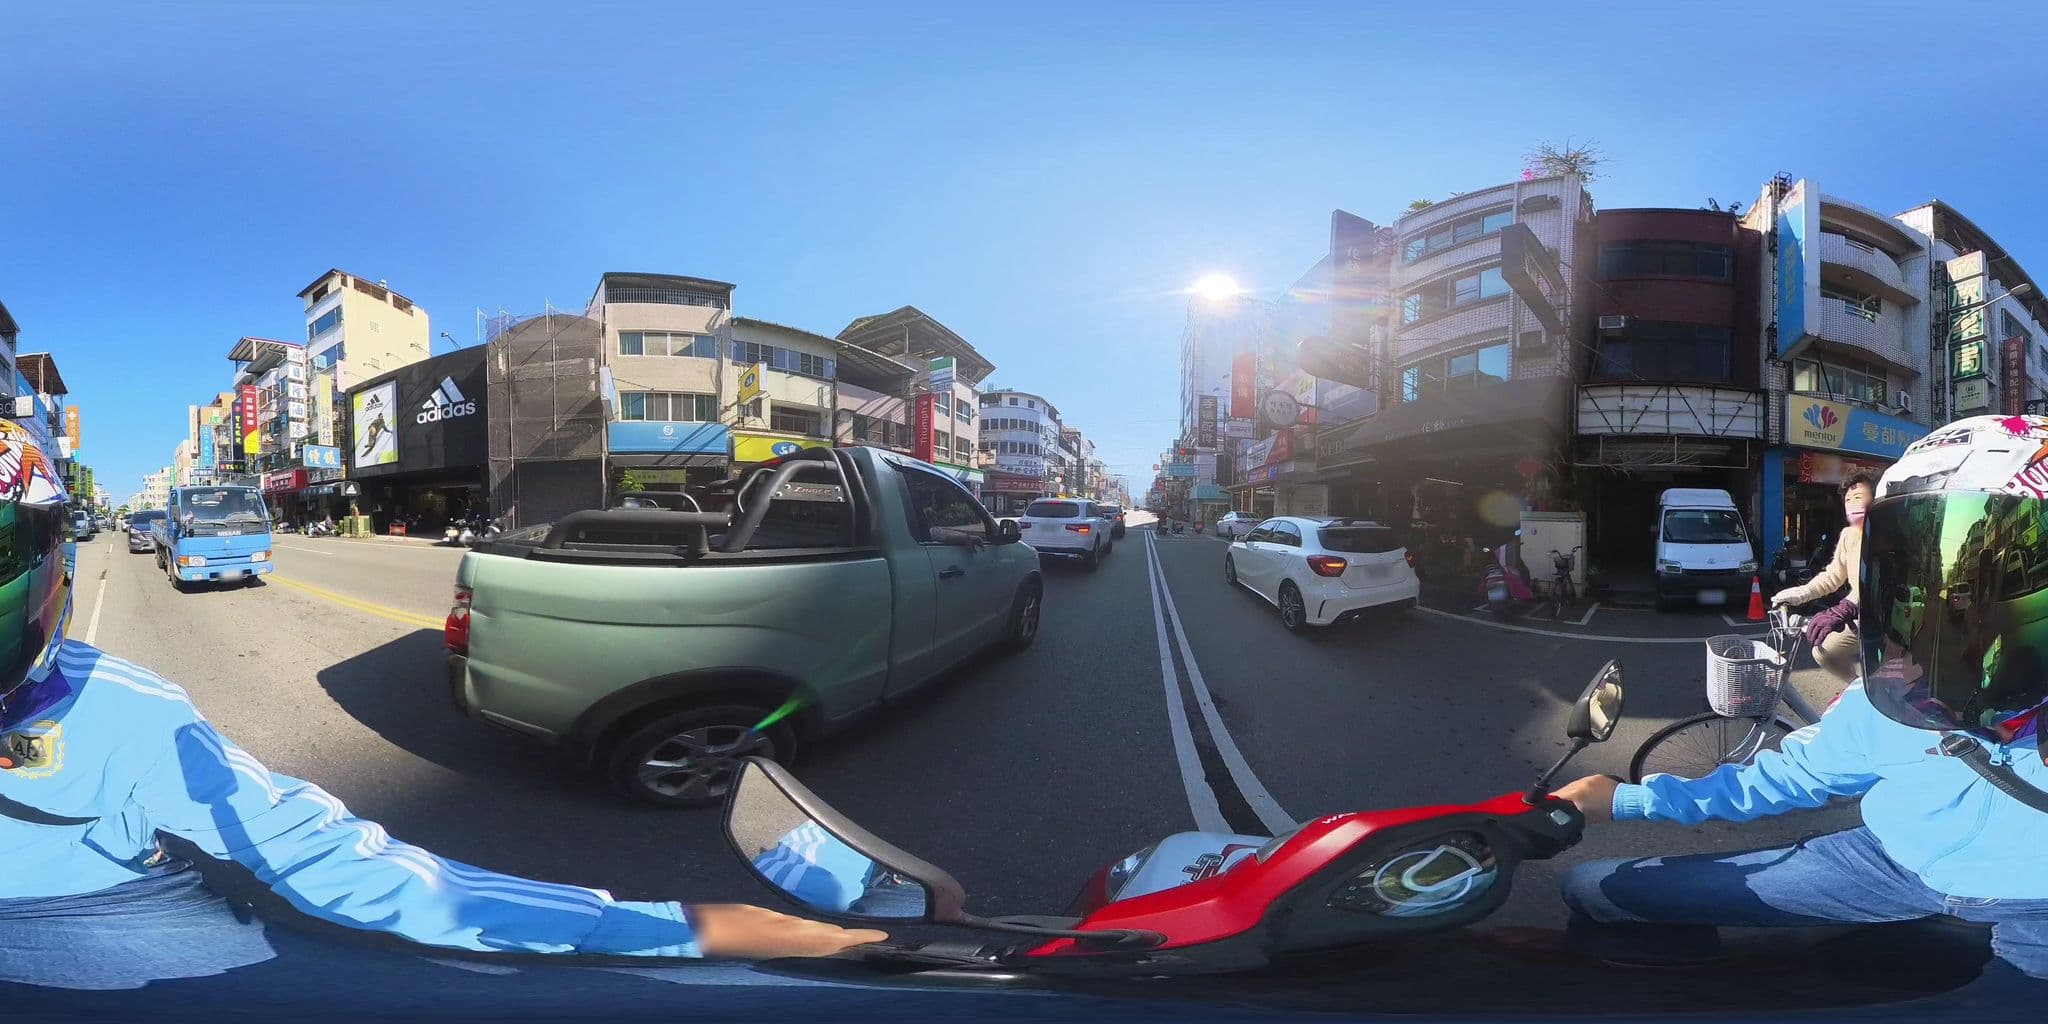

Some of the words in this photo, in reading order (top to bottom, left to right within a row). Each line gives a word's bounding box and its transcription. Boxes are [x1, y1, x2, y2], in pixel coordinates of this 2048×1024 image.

[416, 402, 476, 424] adidas
[921, 407, 929, 446] Triumph
[1804, 429, 1837, 442] mentor
